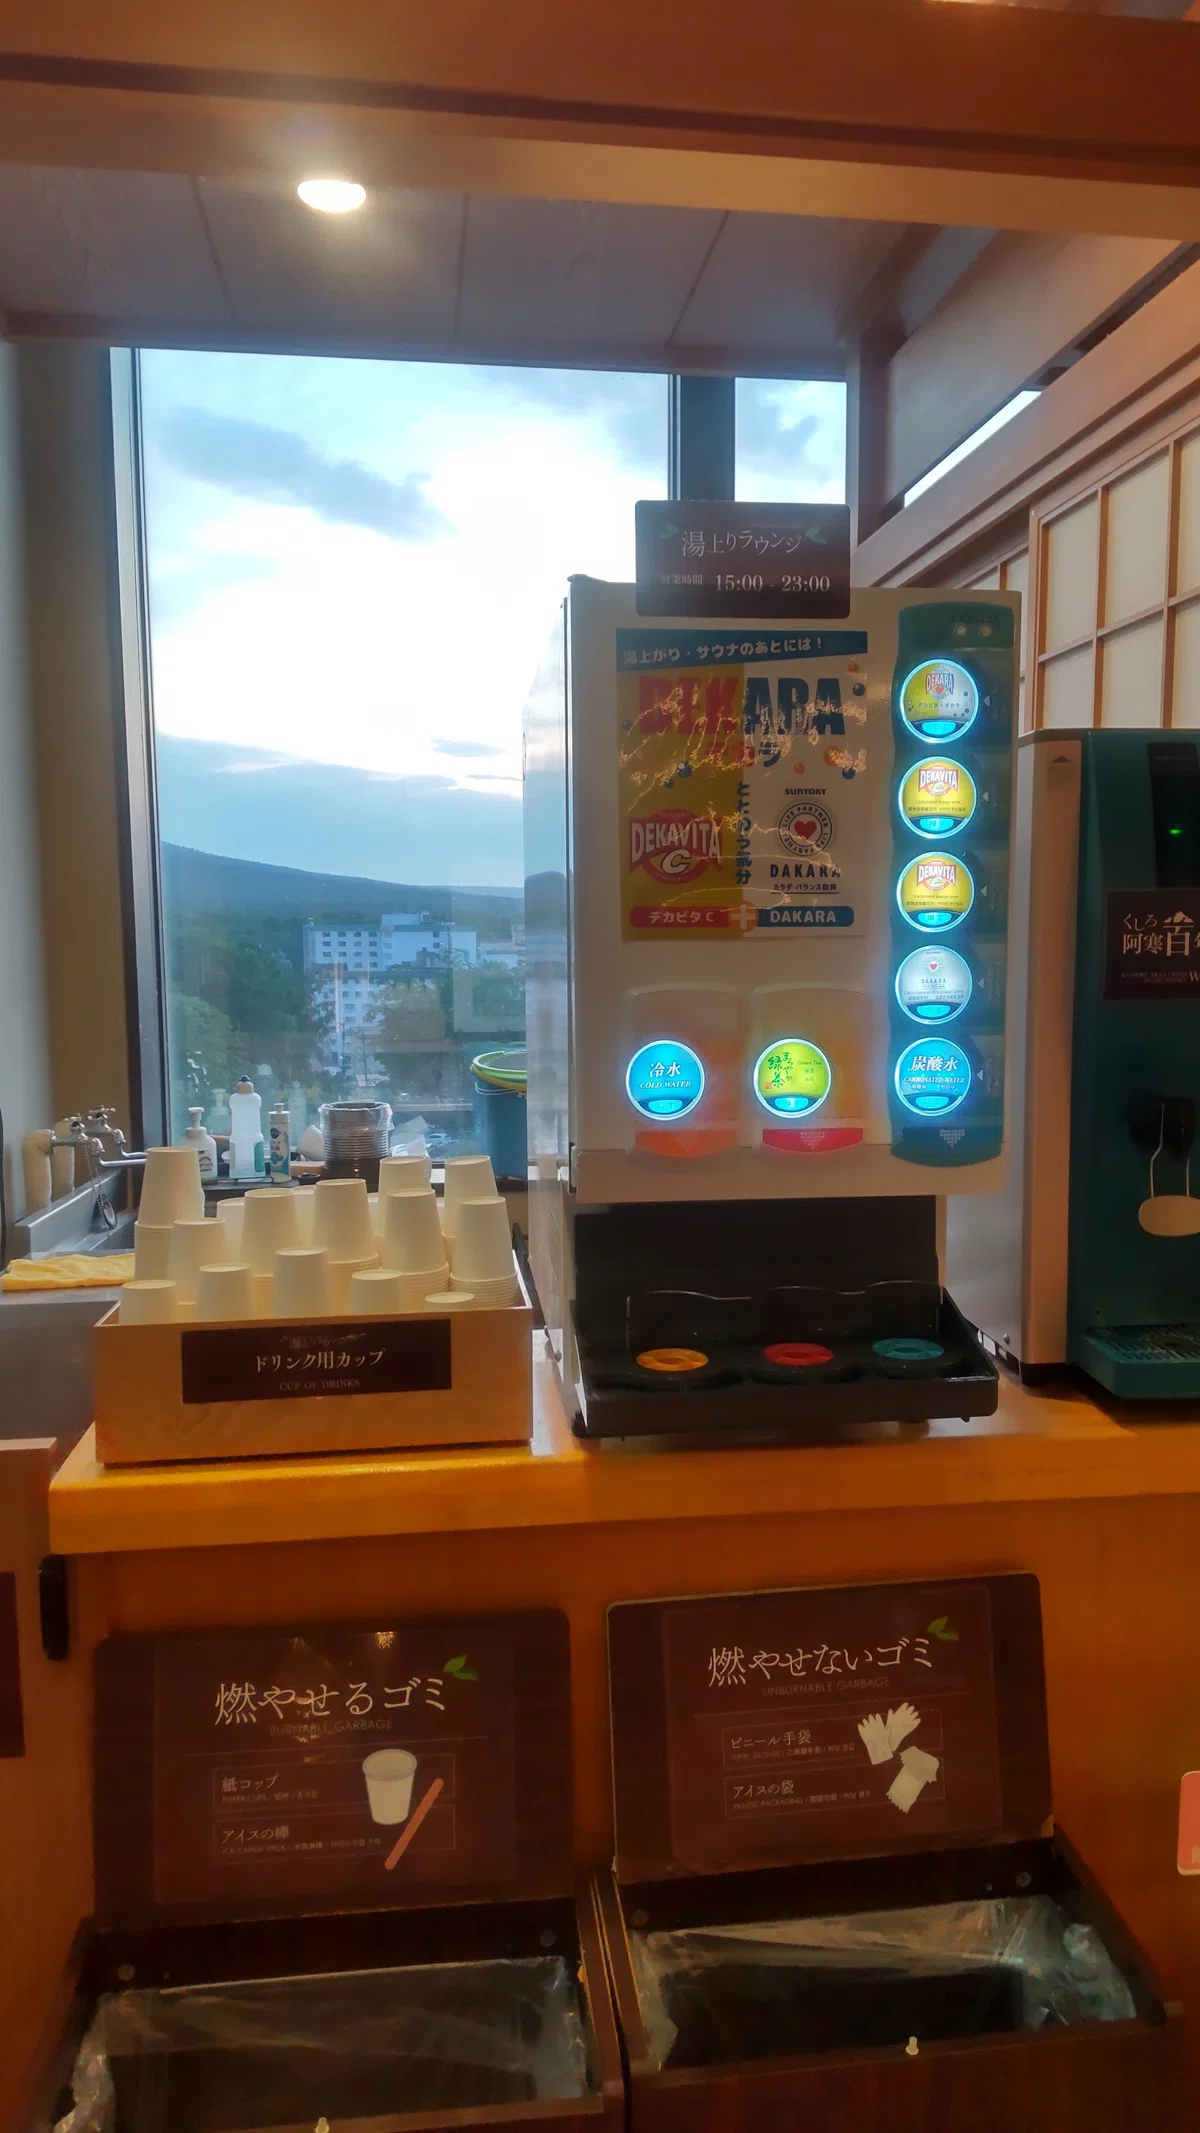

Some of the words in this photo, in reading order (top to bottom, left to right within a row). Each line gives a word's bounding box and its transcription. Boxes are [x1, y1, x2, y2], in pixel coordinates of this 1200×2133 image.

[681, 530, 803, 558] 湯上りラウンジ
[660, 574, 703, 586] 営業時間
[715, 575, 763, 591] 15:00
[781, 575, 830, 592] 23:00
[639, 676, 846, 735] DEKARA
[920, 770, 958, 790] DEKAVITA
[782, 810, 795, 828] LIFE
[797, 806, 829, 828] PARTNER
[631, 823, 721, 864] DEKAVITA
[661, 849, 691, 874] C
[770, 864, 840, 878] DAKARA
[918, 865, 956, 885] DEKAVITA
[648, 911, 701, 923] デカビタ
[705, 912, 714, 922] C
[770, 910, 836, 923] DAKARA
[1123, 912, 1158, 931] くしろ
[649, 1061, 681, 1077] 冷水
[768, 1056, 785, 1088] 緑茶
[911, 1056, 958, 1071] 炭酸水
[256, 1347, 386, 1373] ドリンク用カップ
[279, 1380, 300, 1391] CUP
[322, 1378, 360, 1389] DRINKS
[708, 1637, 932, 1687] 燃やせないゴミ
[763, 1681, 833, 1697] UNBURNABLE
[837, 1677, 889, 1691] GARBAGE
[214, 1676, 445, 1725] 燃やせるゴミ
[335, 1719, 392, 1732] GARBAGE
[221, 1773, 280, 1792] 紙コップ
[733, 1779, 795, 1799] アイスの袋
[222, 1824, 289, 1843] アイスの棒
